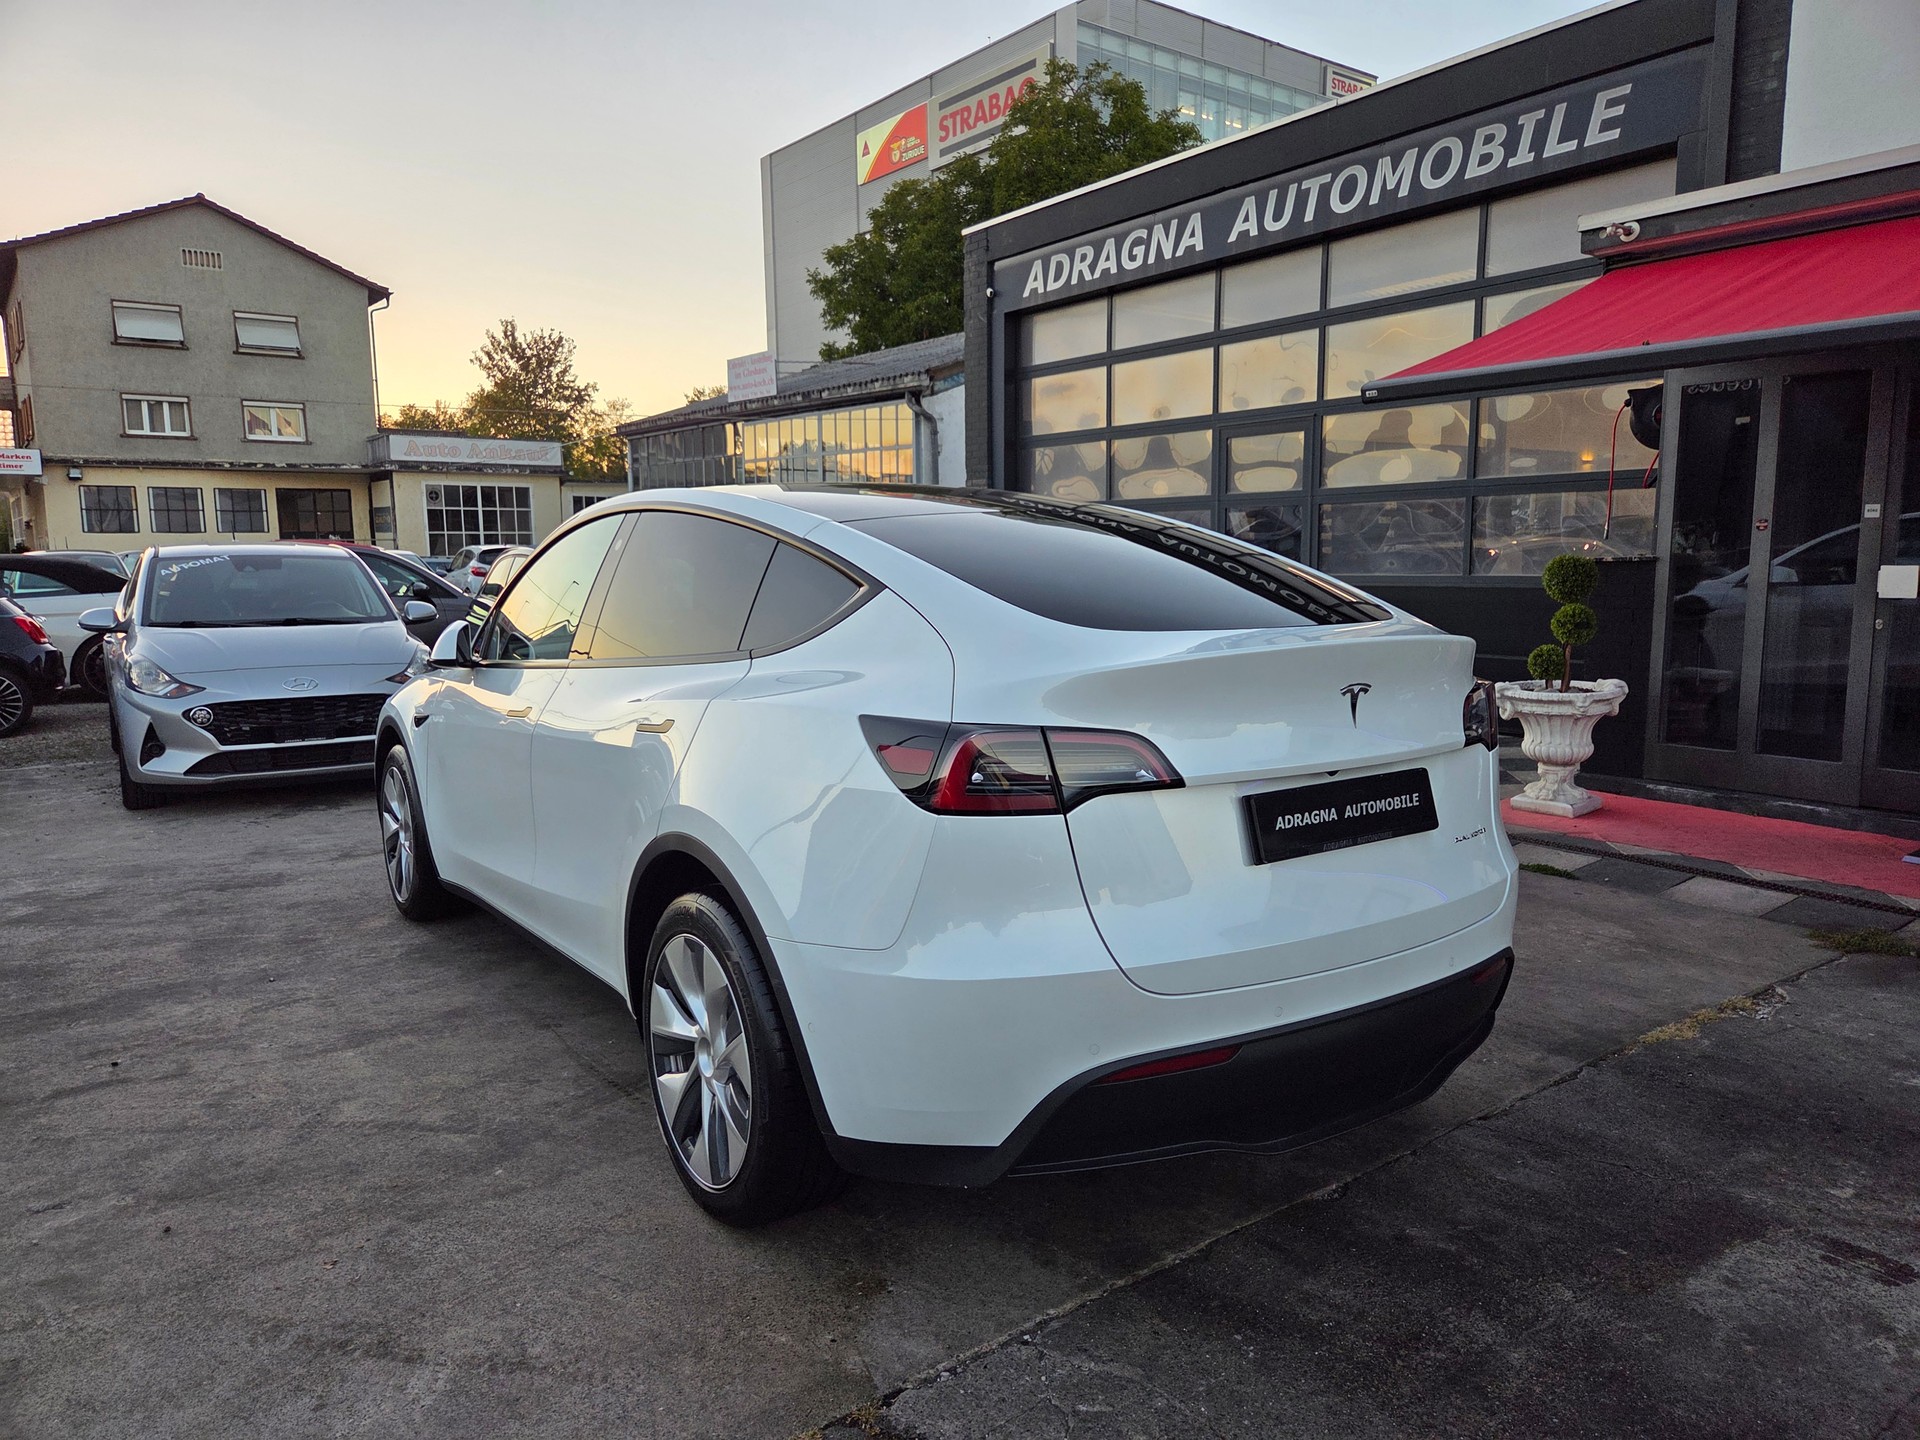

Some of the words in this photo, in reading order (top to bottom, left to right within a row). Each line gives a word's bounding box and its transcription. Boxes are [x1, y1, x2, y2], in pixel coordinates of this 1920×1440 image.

[1022, 213, 1204, 299] ADRAGNA
[1227, 82, 1633, 243] AUTOMOBILE
[404, 440, 461, 458] Auto
[161, 555, 231, 576] AUTOMAT
[1276, 808, 1337, 830] ADRAGNA
[1345, 793, 1419, 818] AUTOMOBILE
